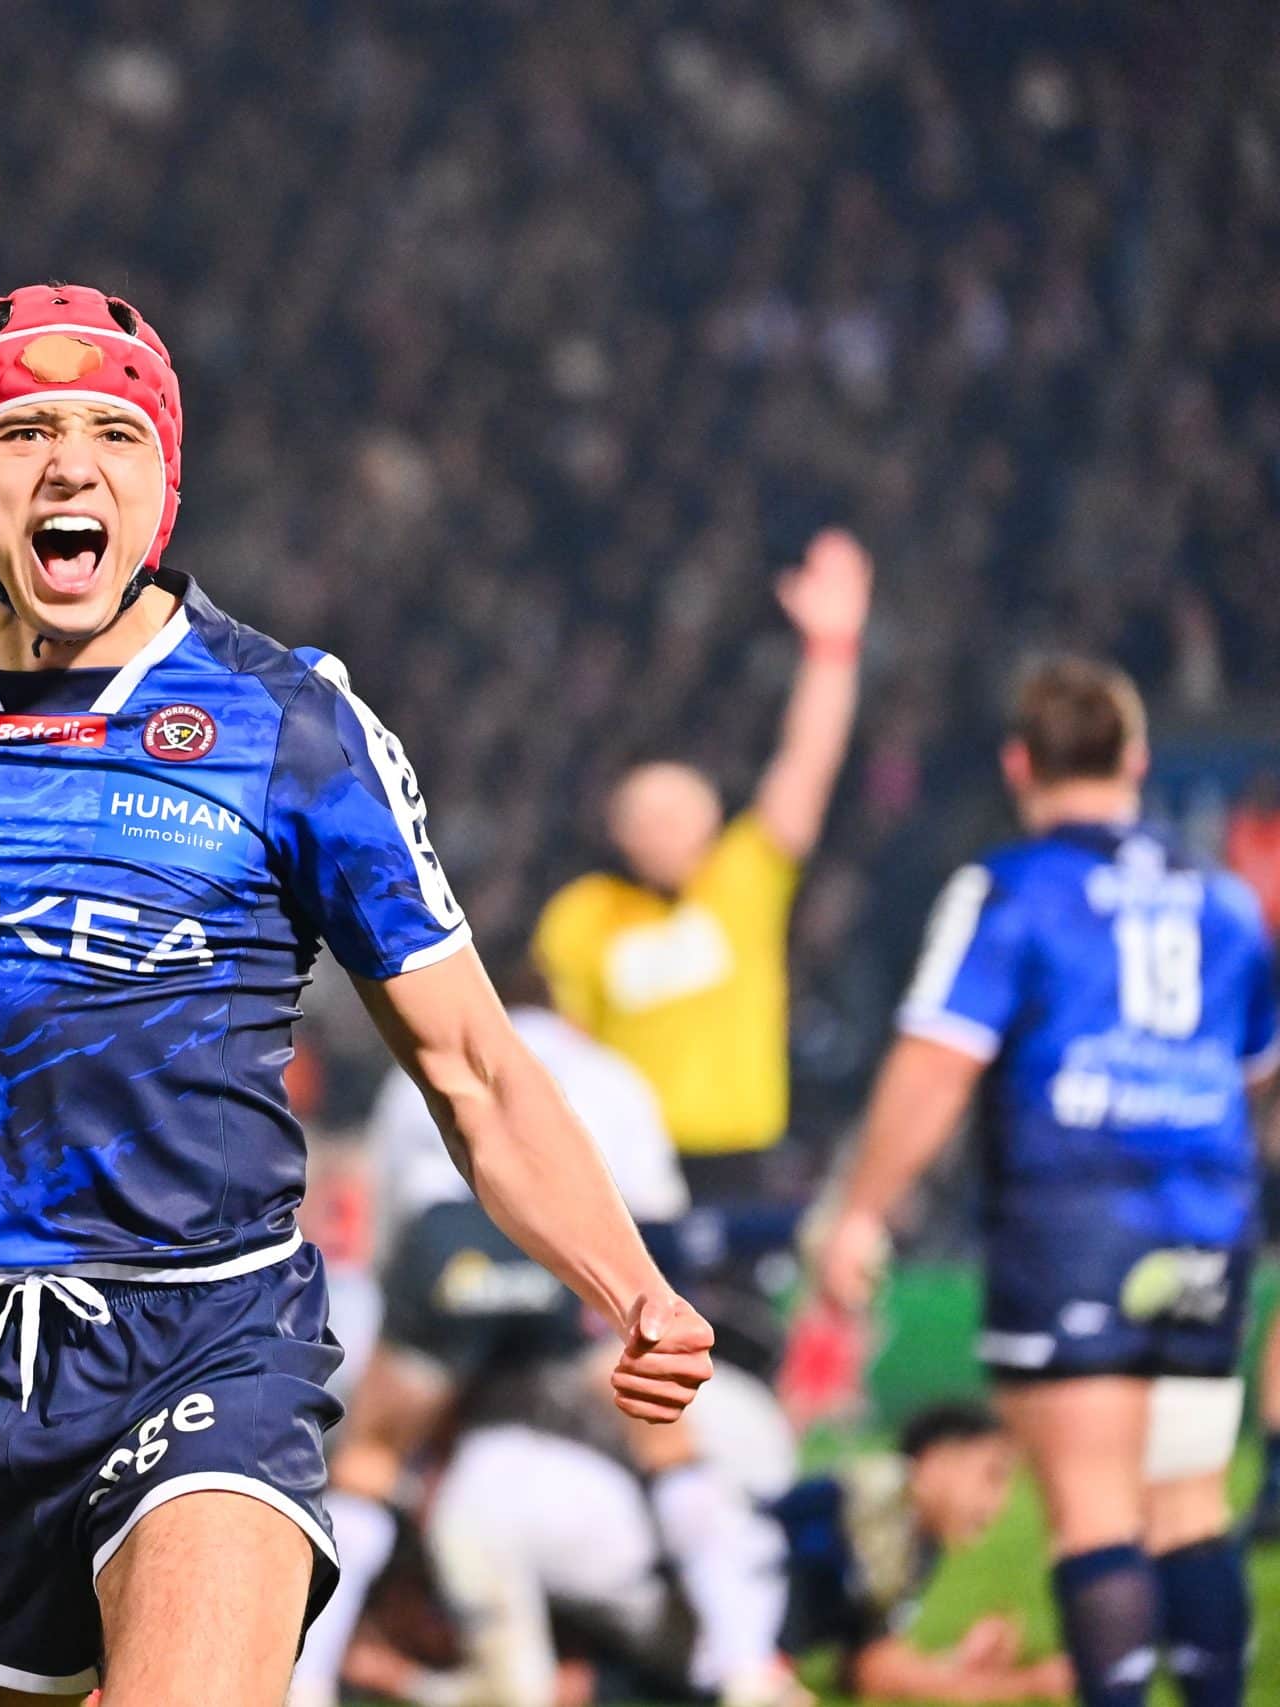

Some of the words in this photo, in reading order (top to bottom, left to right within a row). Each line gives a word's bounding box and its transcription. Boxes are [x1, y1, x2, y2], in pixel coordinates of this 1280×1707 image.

[146, 721, 158, 746] UNION
[160, 706, 206, 721] BORDEAUX
[111, 792, 240, 835] HUMAN
[122, 823, 223, 852] Immobilier
